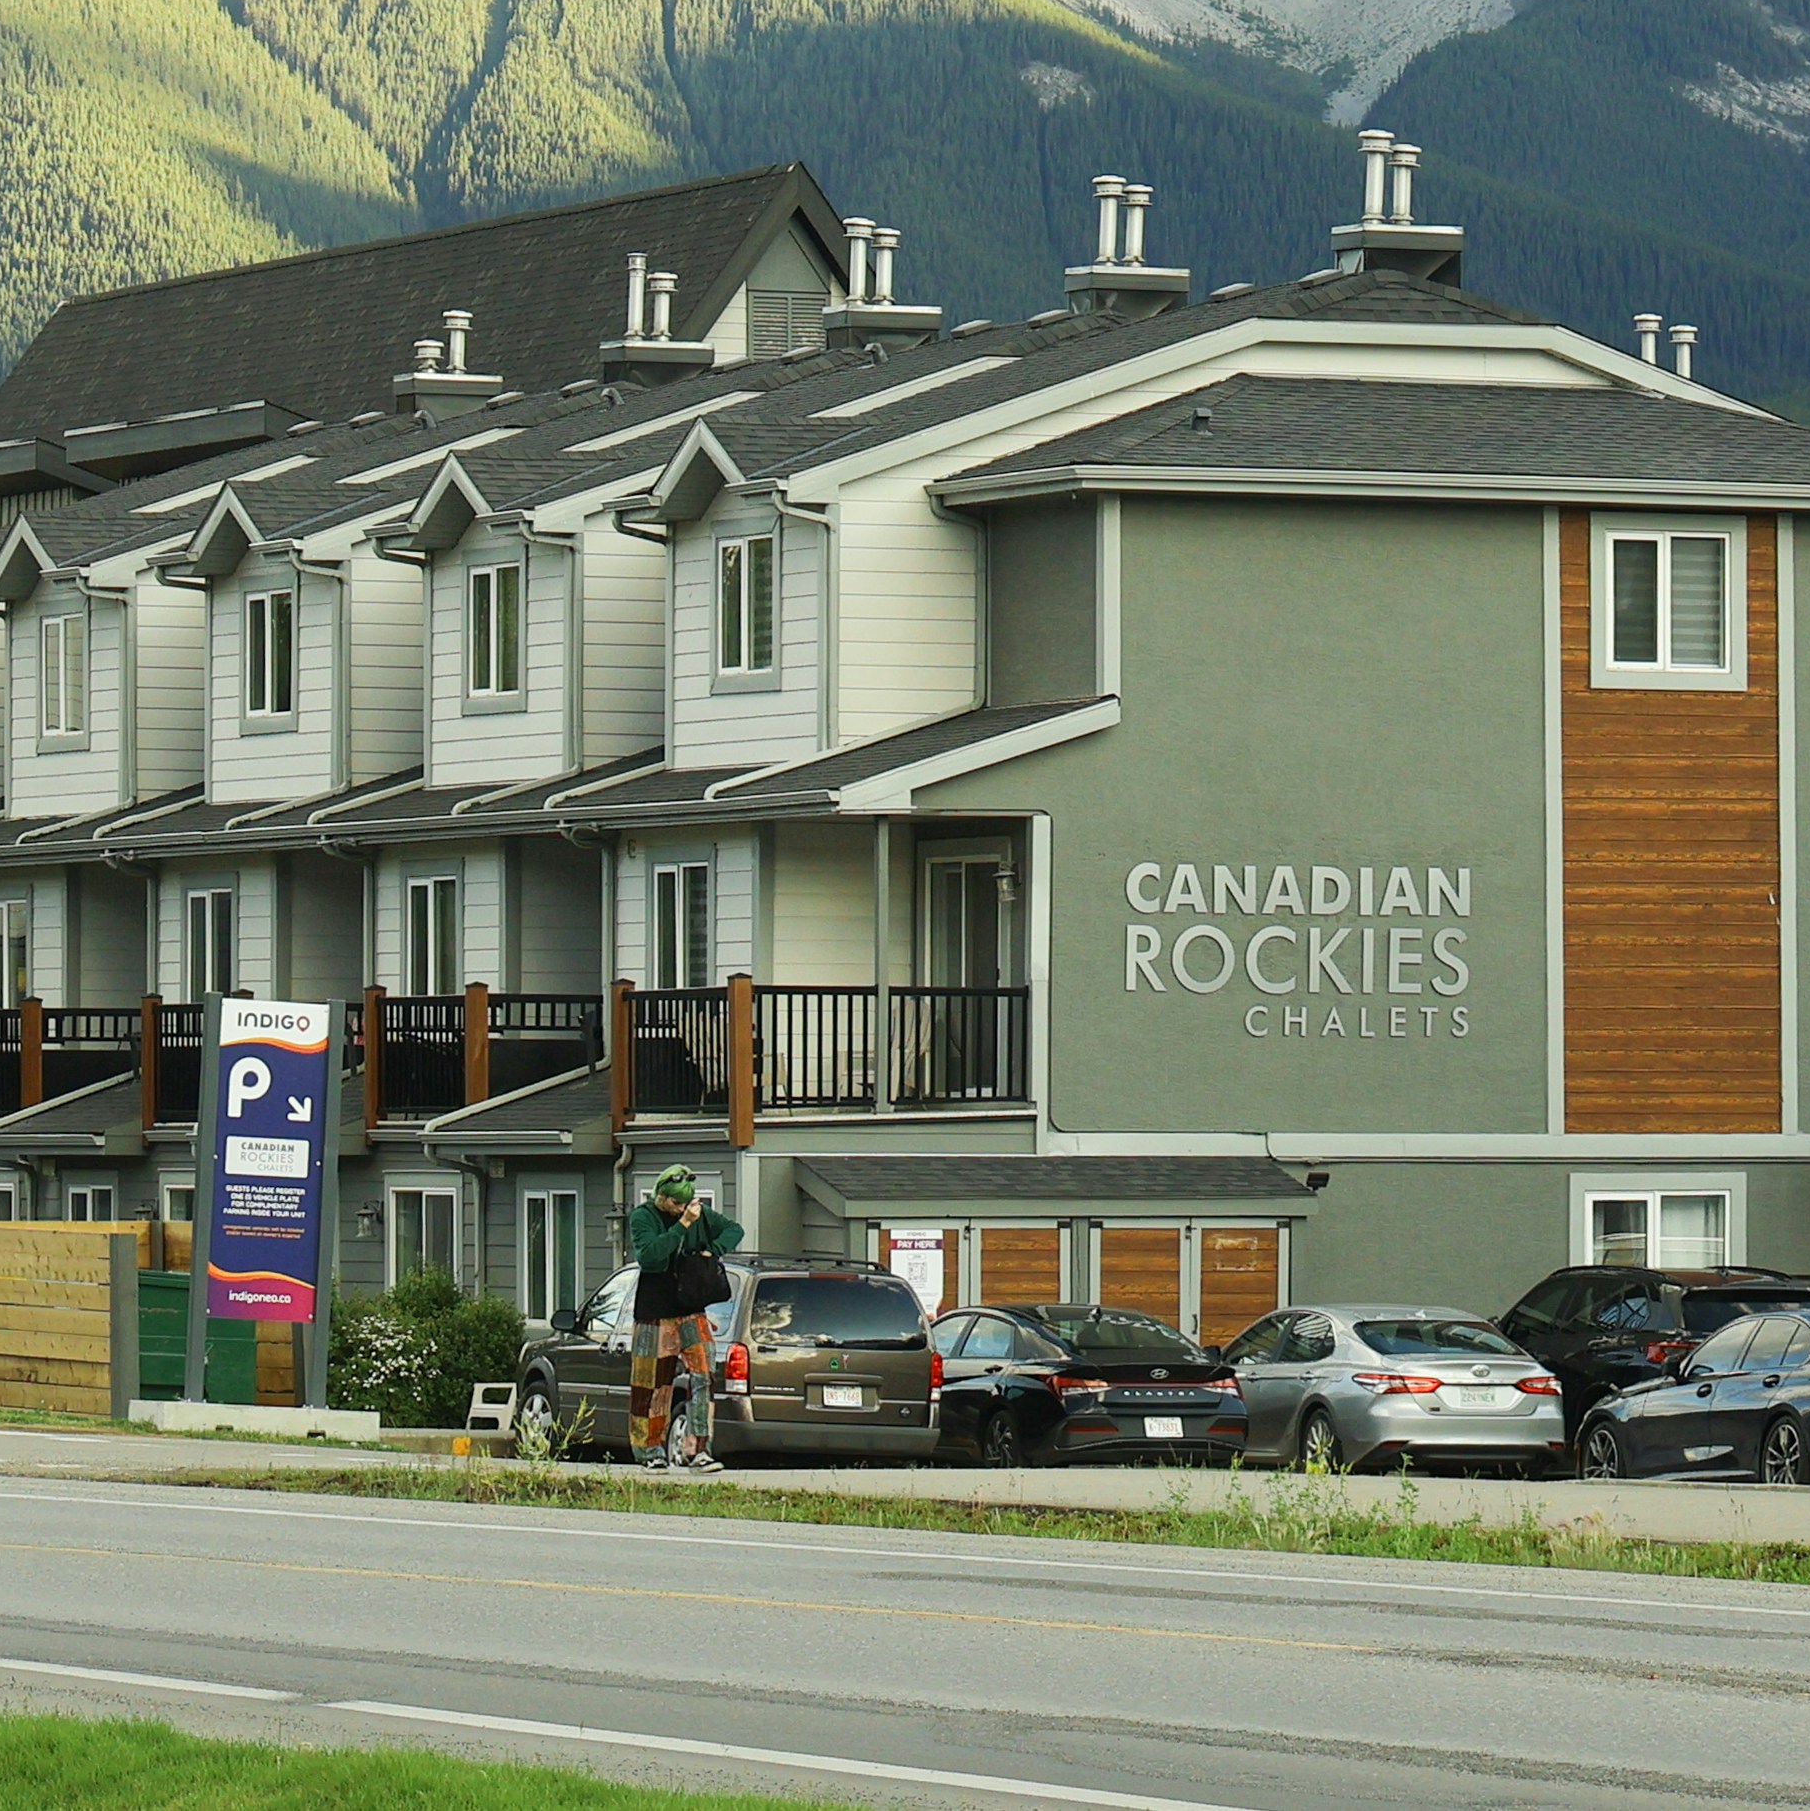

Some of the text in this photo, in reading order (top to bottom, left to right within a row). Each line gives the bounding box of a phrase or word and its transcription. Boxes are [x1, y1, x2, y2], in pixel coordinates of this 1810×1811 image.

[1125, 861, 1471, 918] CANADIAN
[1124, 924, 1470, 997] ROCKIES
[237, 1012, 310, 1032] INDIGO
[1244, 1005, 1470, 1038] CHALETS
[227, 1056, 272, 1118] P
[241, 1142, 295, 1152] CANADIAN
[240, 1152, 294, 1164] ROCKIES
[257, 1164, 294, 1173] CHALETS
[897, 1240, 937, 1249] PAY HERE
